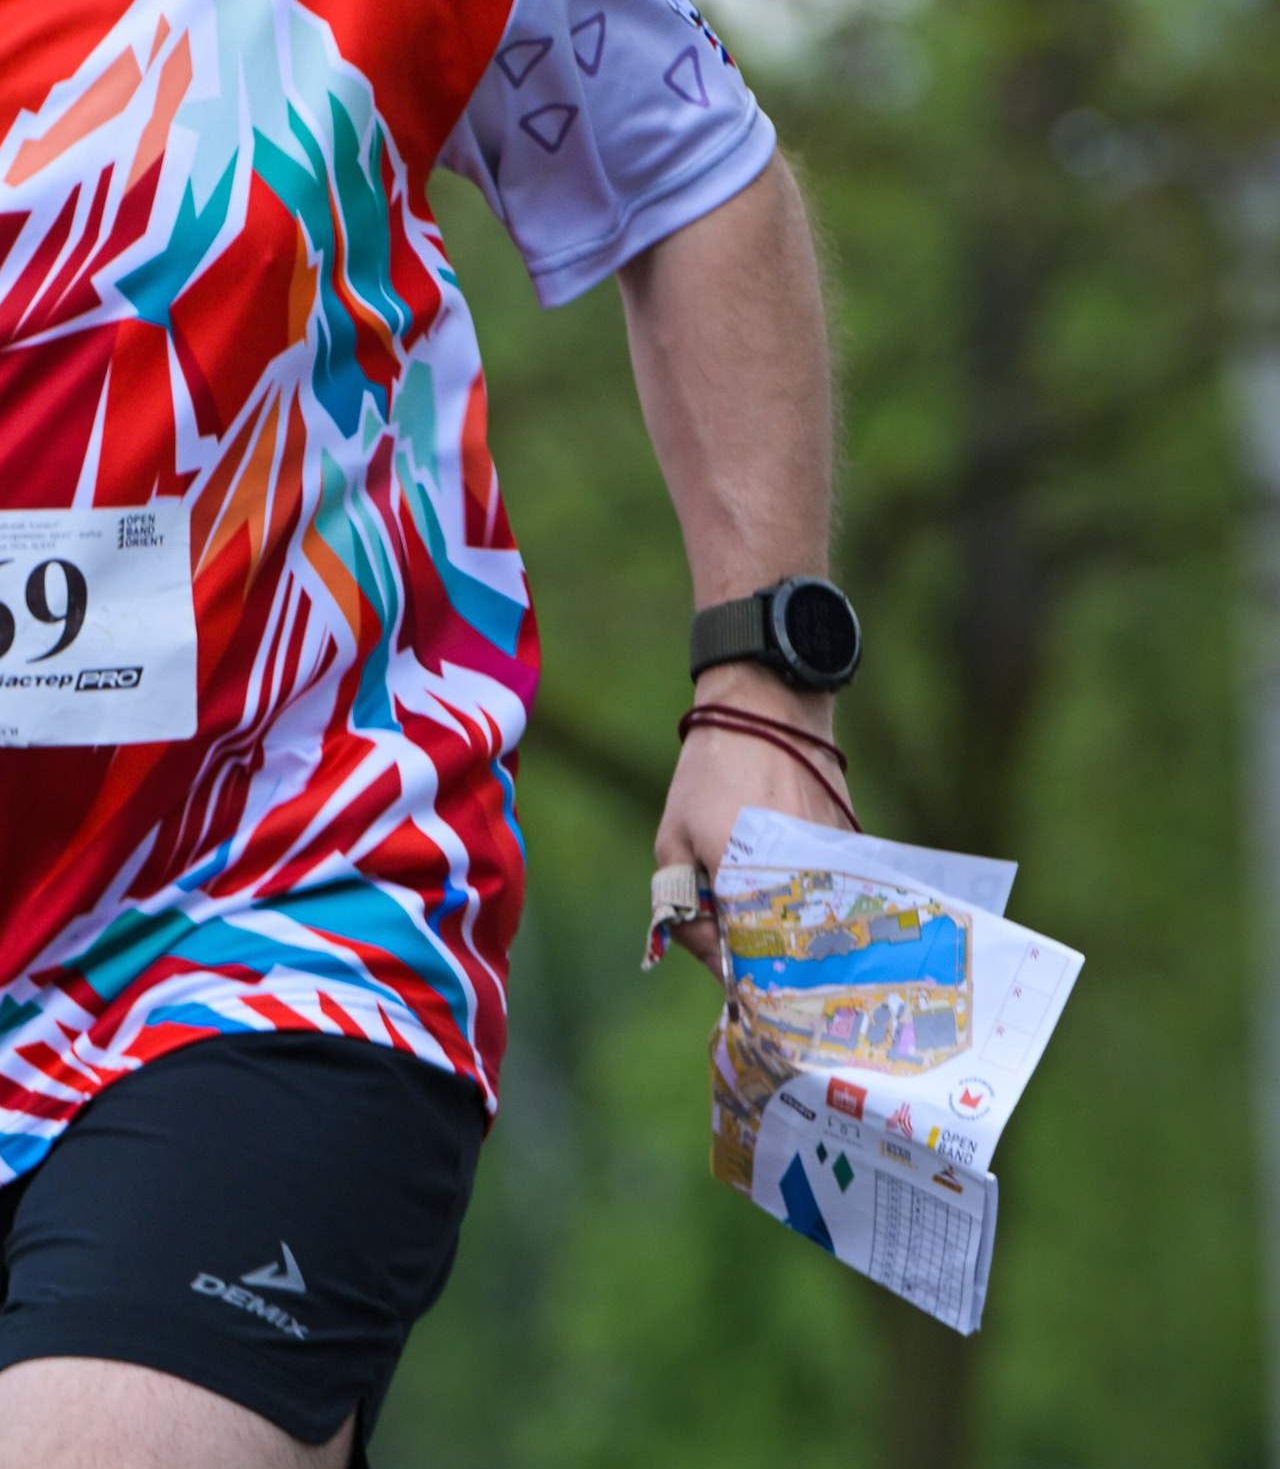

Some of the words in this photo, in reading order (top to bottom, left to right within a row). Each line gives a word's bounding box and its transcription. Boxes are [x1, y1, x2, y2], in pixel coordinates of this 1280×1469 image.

[77, 668, 140, 690] PRO
[942, 1130, 977, 1153] OPEN
[938, 1142, 974, 1165] BAND
